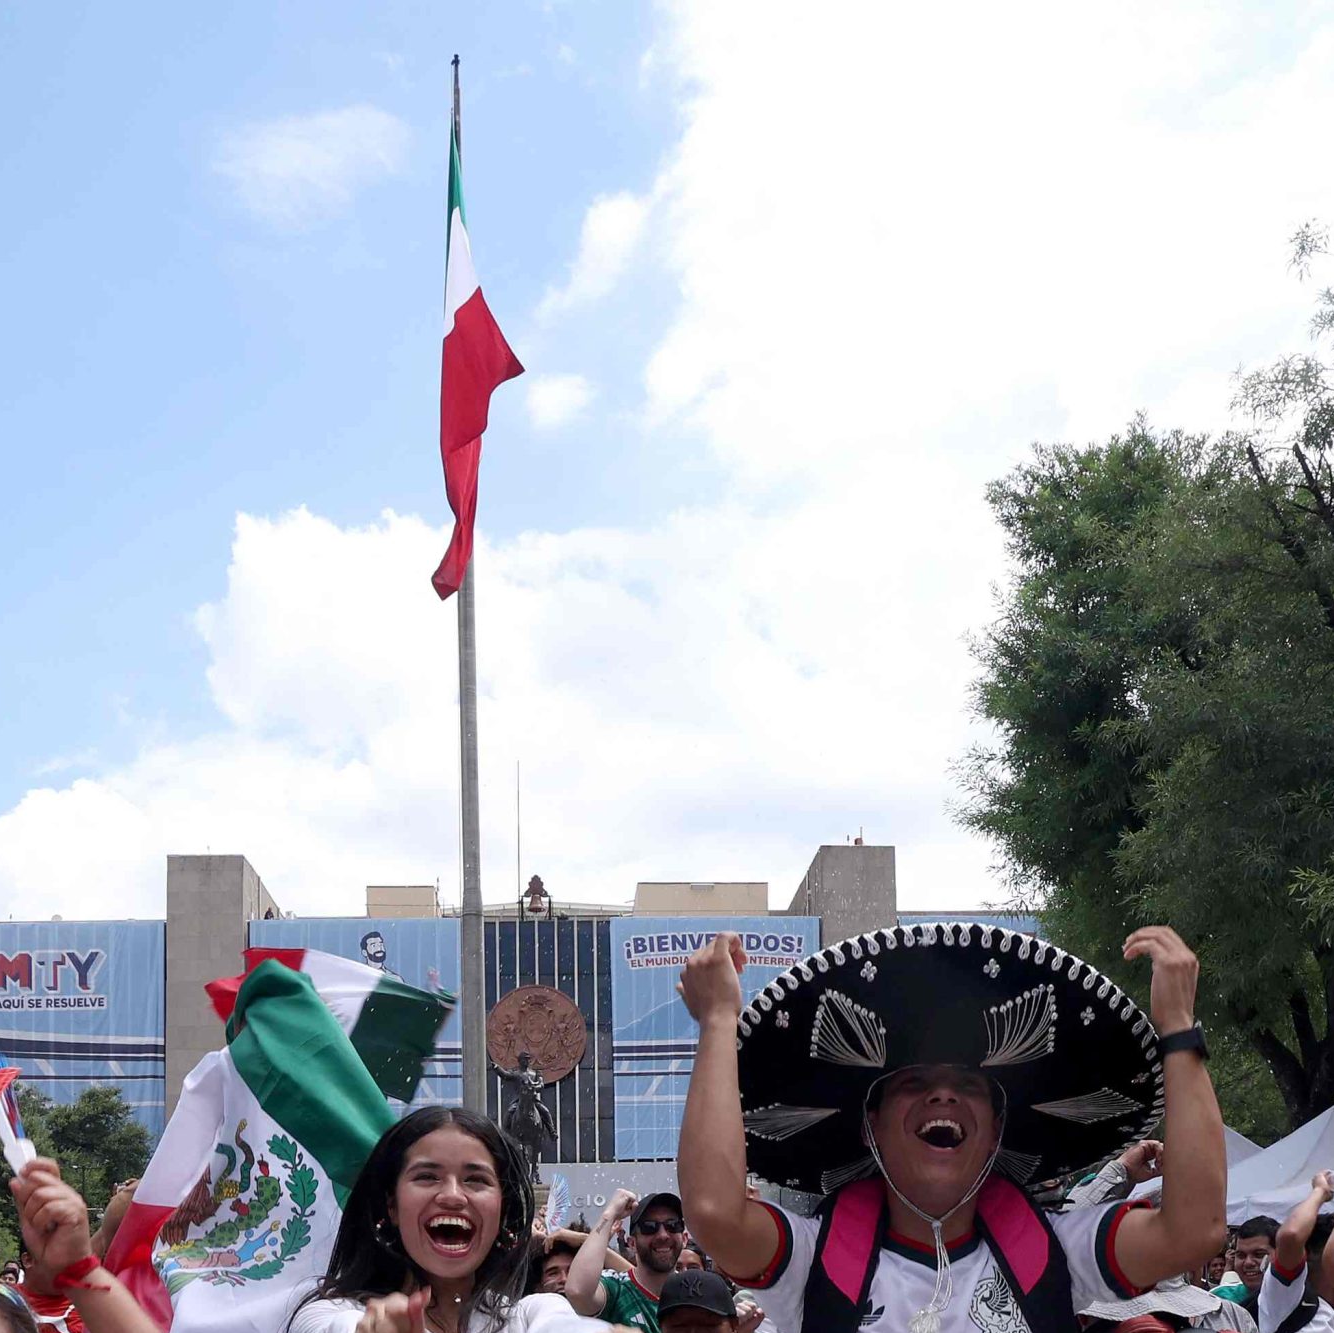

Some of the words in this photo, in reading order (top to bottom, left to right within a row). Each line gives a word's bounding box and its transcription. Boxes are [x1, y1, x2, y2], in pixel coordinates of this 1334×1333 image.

[625, 933, 803, 959] ¡BIENVEIDOS!
[631, 959, 643, 968] EL
[645, 956, 689, 967] MUNDIA
[749, 956, 798, 967] NTERREY
[28, 999, 42, 1009] SE
[46, 997, 105, 1008] RESUELVE
